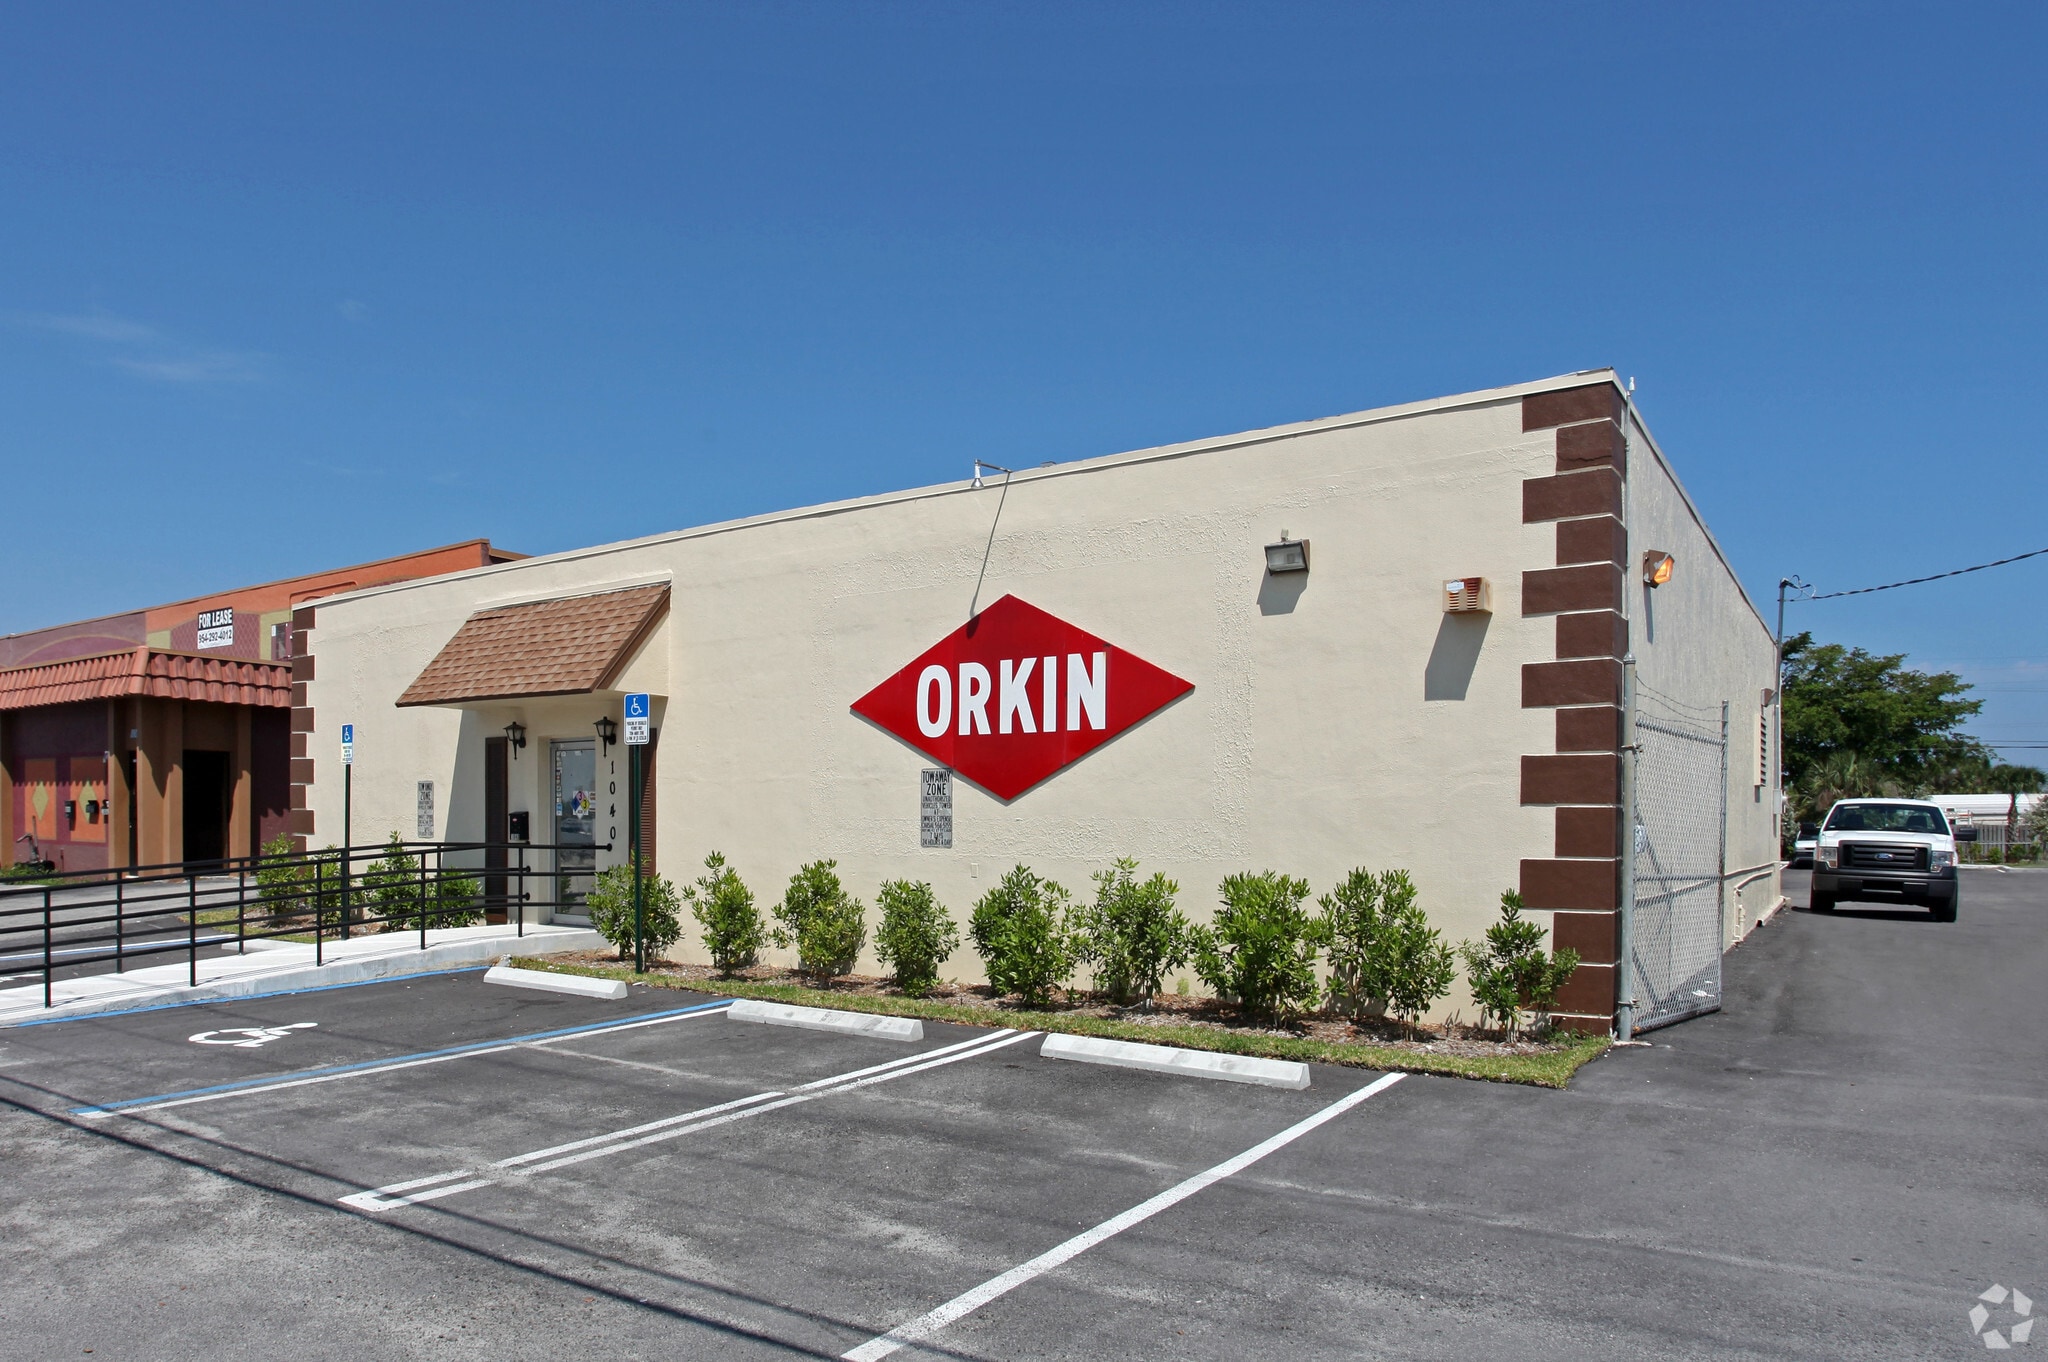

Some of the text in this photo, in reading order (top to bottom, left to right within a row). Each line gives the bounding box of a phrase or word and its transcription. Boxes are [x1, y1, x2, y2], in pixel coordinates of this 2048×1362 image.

[198, 609, 232, 629] FOR LEASE
[916, 651, 1106, 738] ORKIN
[927, 783, 946, 795] ZONE
